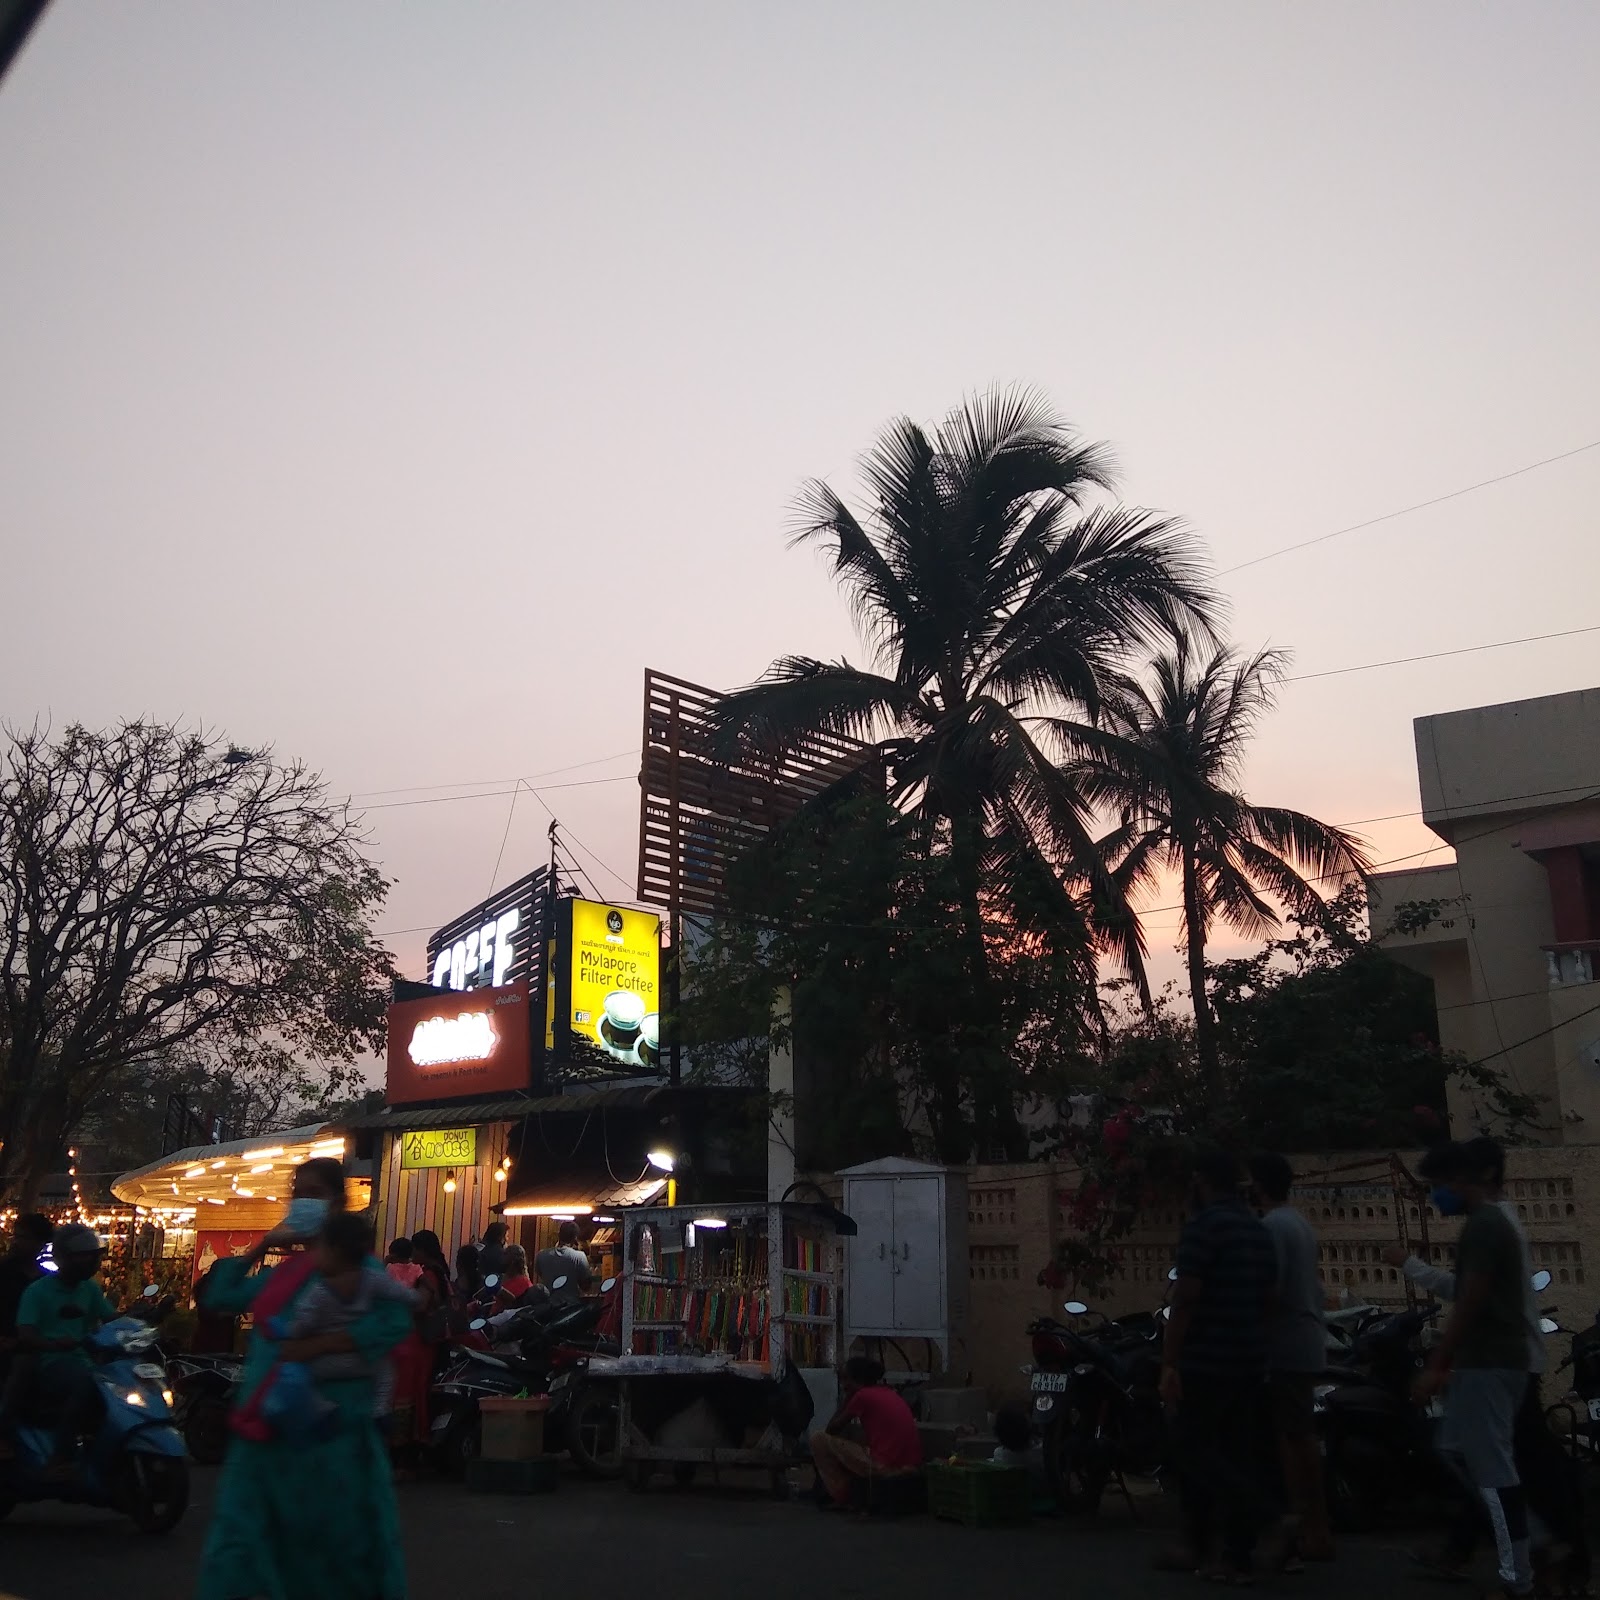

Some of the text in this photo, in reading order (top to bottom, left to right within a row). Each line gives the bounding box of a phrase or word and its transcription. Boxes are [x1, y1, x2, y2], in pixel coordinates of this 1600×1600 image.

[580, 950, 637, 974] Mylapore
[580, 967, 654, 993] Filter Coffee
[443, 1131, 468, 1141] DONUT
